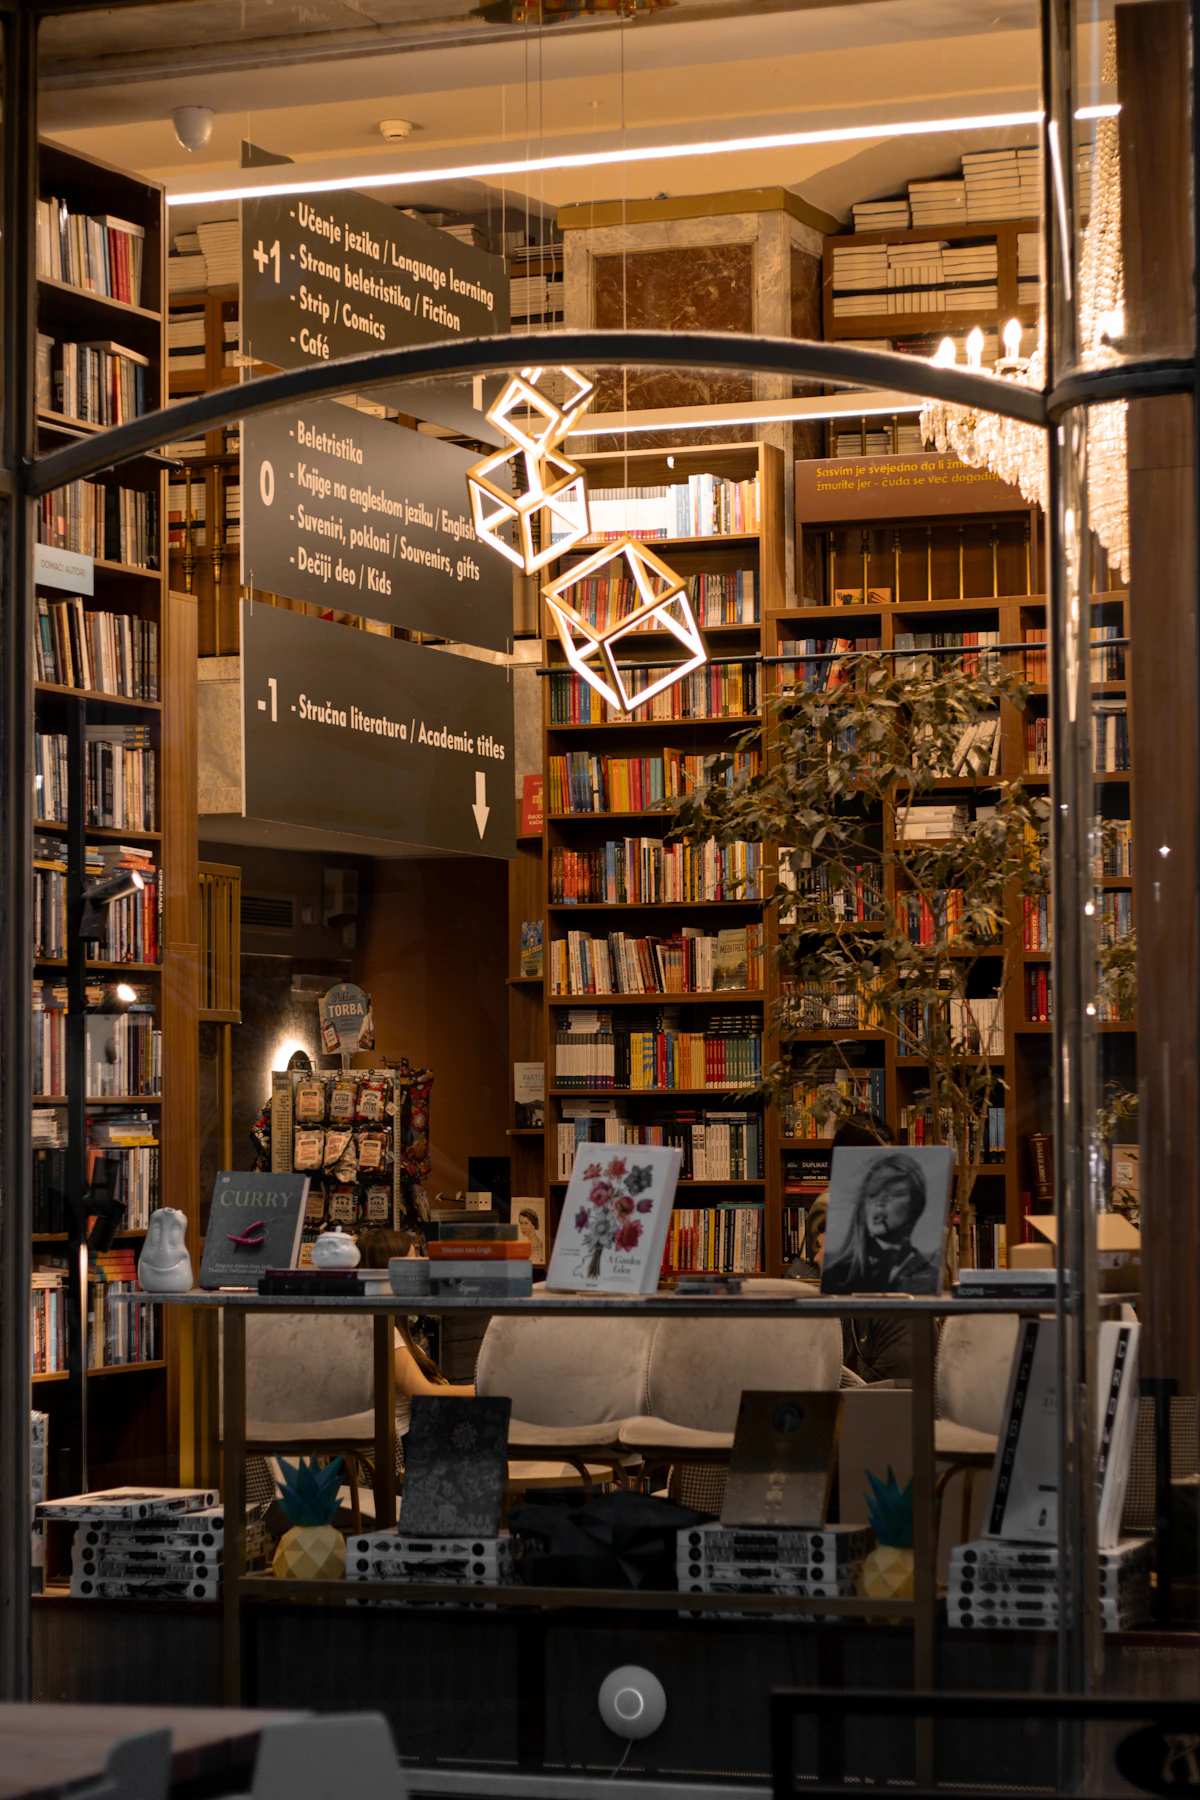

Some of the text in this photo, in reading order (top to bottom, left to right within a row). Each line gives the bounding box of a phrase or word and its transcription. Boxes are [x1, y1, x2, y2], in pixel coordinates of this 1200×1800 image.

[253, 239, 281, 284] +1
[298, 202, 341, 244] Učenje
[344, 223, 380, 261] jezika
[383, 240, 389, 264] /
[392, 243, 446, 291] Language
[450, 268, 494, 311] learning
[300, 244, 341, 283] Strana
[345, 264, 411, 311] beletristika
[414, 293, 420, 316] /
[422, 296, 461, 332] Fiction
[300, 285, 330, 324] Strip
[333, 300, 340, 324] /
[343, 304, 386, 341] Comics
[300, 328, 330, 360] Café
[297, 420, 363, 465] Beletristika
[816, 468, 853, 477] Sasvim
[855, 465, 866, 477] je
[869, 462, 918, 476] svejedno
[921, 461, 936, 471] da
[938, 460, 945, 470] li
[817, 479, 855, 491] žmurite
[857, 479, 871, 490] jer
[882, 476, 911, 487] čuda
[913, 477, 925, 485] se
[928, 472, 948, 484] već
[952, 472, 999, 484] događaj
[297, 463, 331, 499] Knjige
[334, 483, 347, 500] na
[350, 486, 402, 518] engleskom
[405, 500, 433, 529] jeziku
[435, 508, 441, 532] /
[442, 510, 475, 542] English
[297, 505, 347, 545] Suveniri,
[350, 526, 390, 554] pokloni
[393, 534, 398, 558] /
[400, 537, 454, 577] Souvenirs,
[457, 556, 480, 582] gifts
[65, 566, 86, 577] AUTORI
[298, 546, 332, 583] Dečiji
[335, 559, 356, 585] deo
[359, 564, 364, 590] /
[367, 567, 392, 595] Kids
[257, 677, 278, 722] -1
[299, 694, 347, 728] Stručna
[351, 706, 407, 740] literatura
[410, 719, 416, 744] /
[418, 721, 474, 754] Academic
[477, 736, 505, 761] titles
[328, 1003, 364, 1018] TORBA
[220, 1190, 293, 1208] CURRY
[477, 1246, 492, 1255] Gogh
